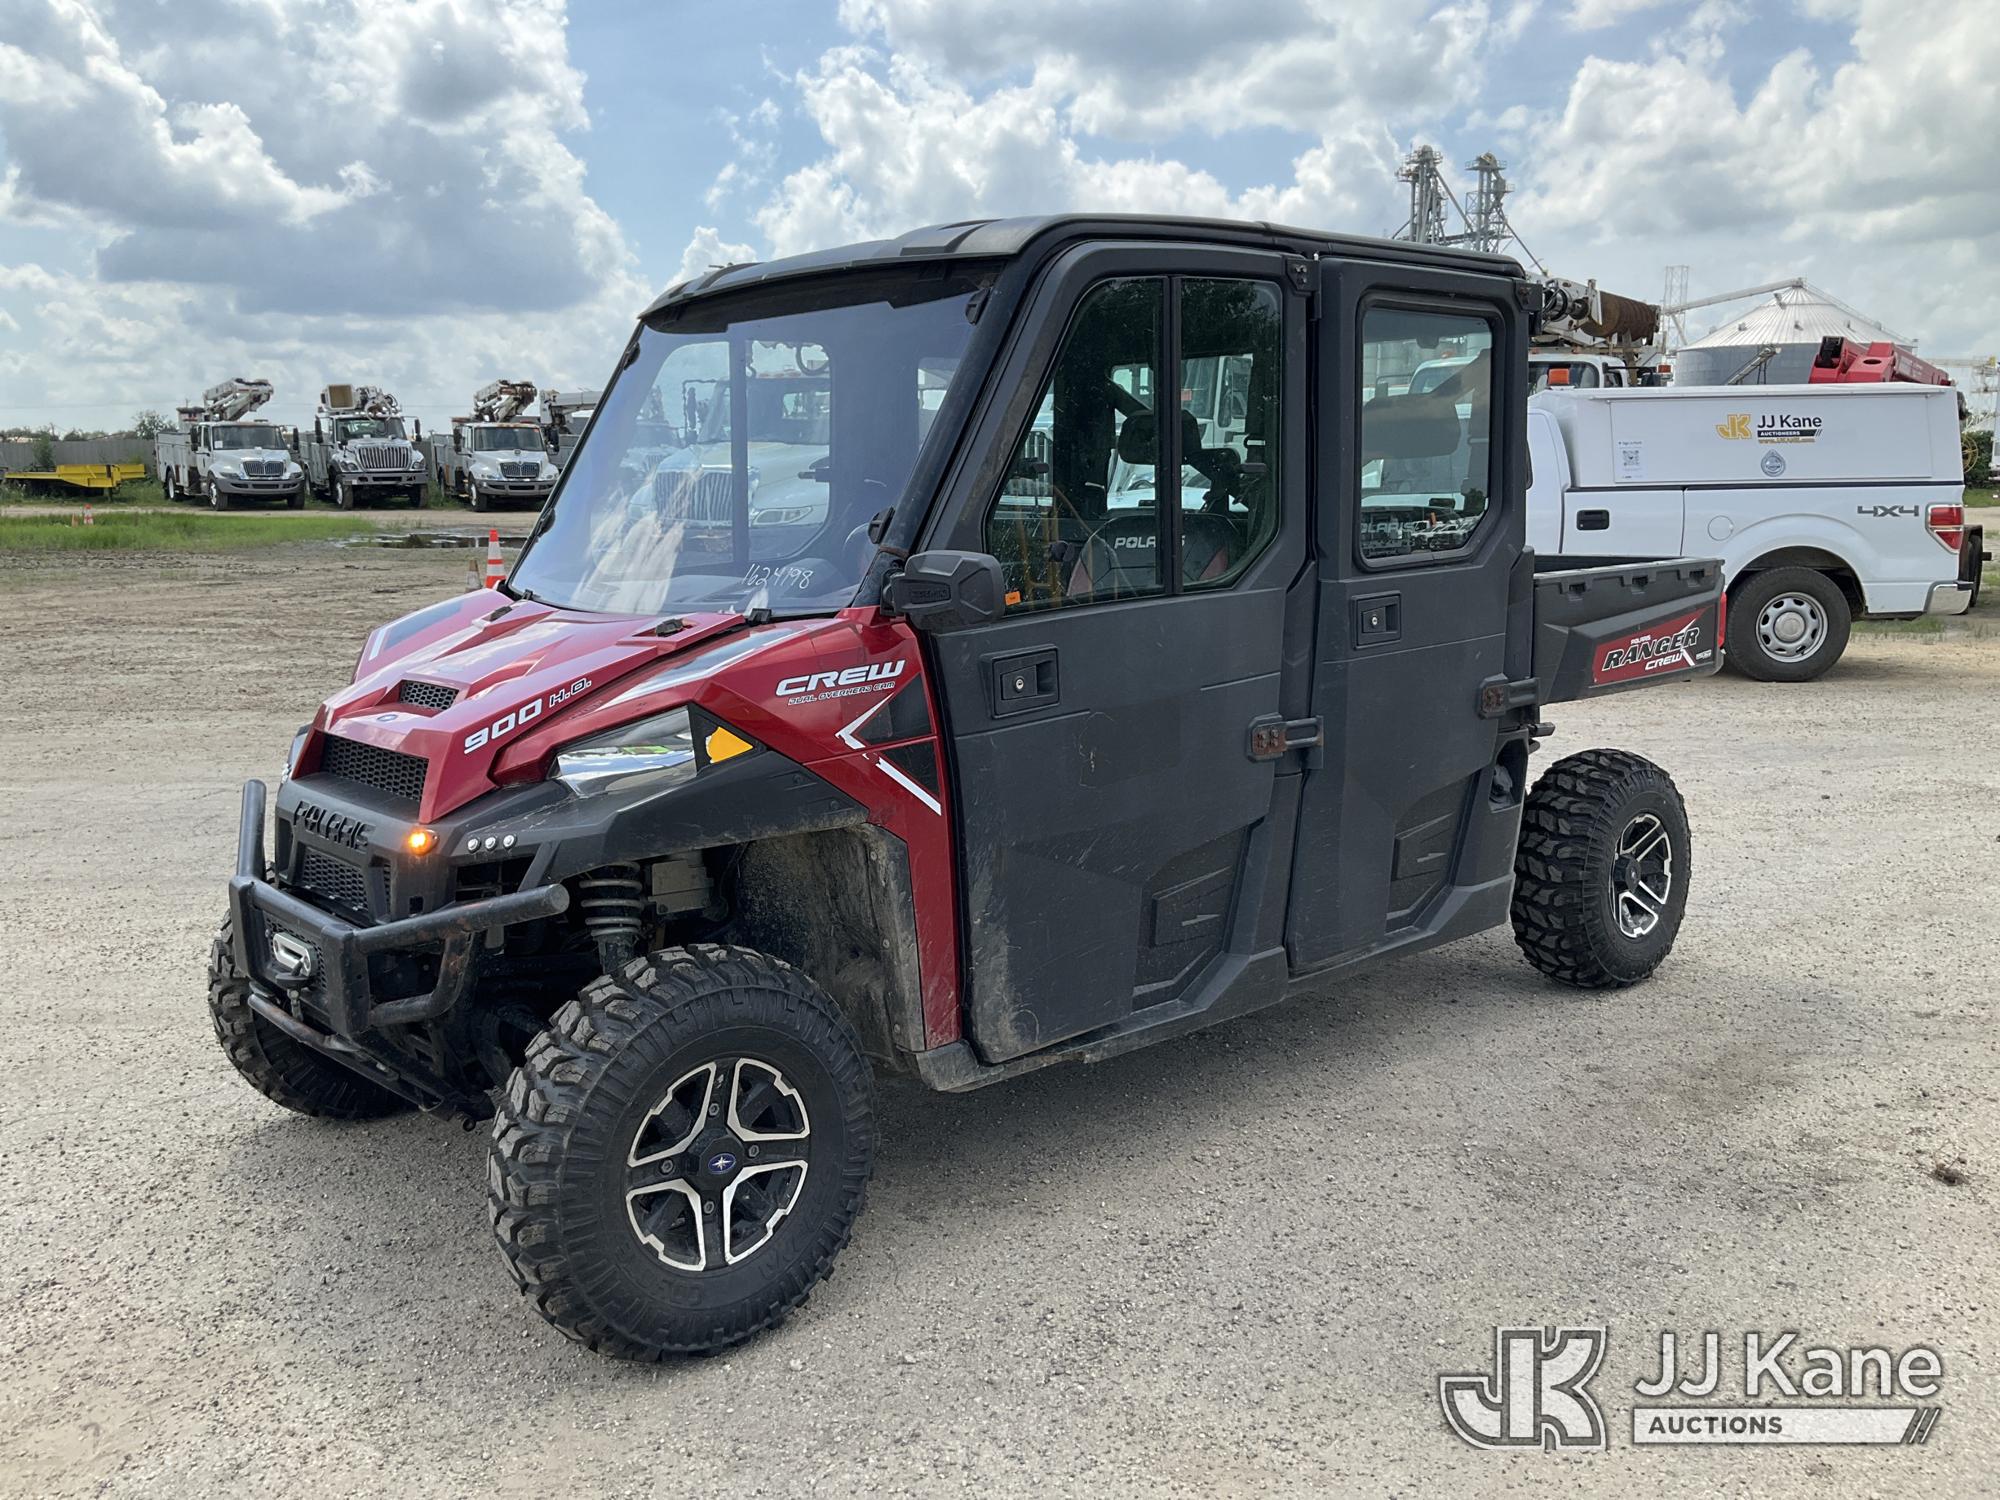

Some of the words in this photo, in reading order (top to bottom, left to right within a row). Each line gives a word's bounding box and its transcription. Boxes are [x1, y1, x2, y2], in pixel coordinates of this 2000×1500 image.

[1757, 414, 1776, 428] JJ
[1780, 414, 1822, 428] Kane
[1360, 522, 1416, 534] OLARIS
[1114, 535, 1186, 549] POLA
[741, 563, 814, 589] 1624198
[1601, 627, 1700, 671] RANGER
[776, 660, 905, 695] CREW
[788, 694, 817, 705] DUAL
[819, 684, 871, 700] OVERHEAD
[873, 681, 895, 692] CAM
[464, 698, 543, 754] 900
[293, 800, 376, 853] POLARIS
